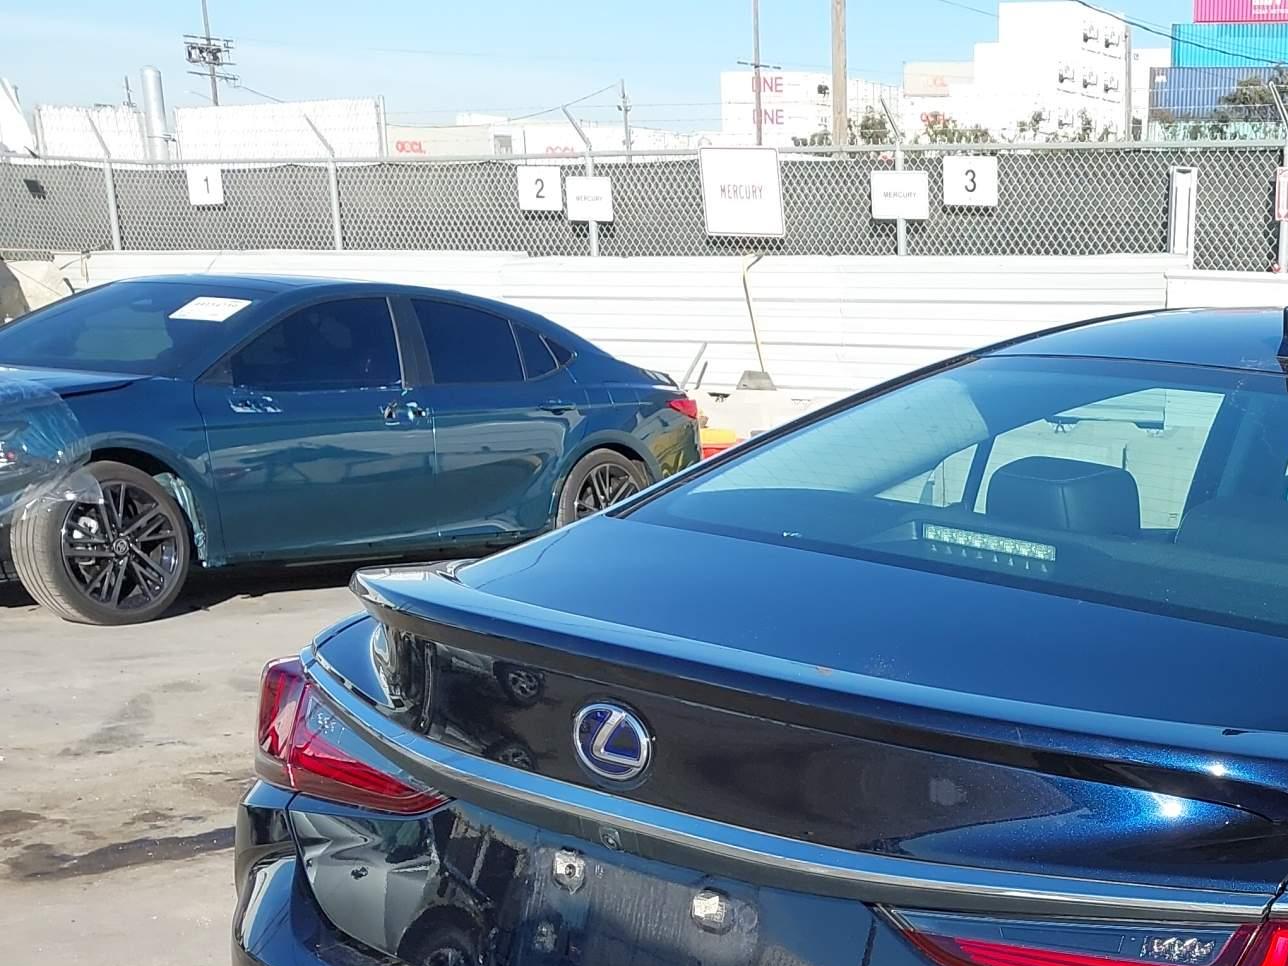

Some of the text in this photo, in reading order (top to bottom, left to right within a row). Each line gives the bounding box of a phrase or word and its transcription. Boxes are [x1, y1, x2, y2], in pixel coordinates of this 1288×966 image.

[752, 76, 784, 93] ONE
[753, 109, 784, 125] ONE
[203, 175, 210, 194] 1
[534, 178, 546, 199] 2
[964, 169, 977, 193] 3
[720, 184, 763, 199] MERCURY
[883, 191, 917, 199] MERCURY
